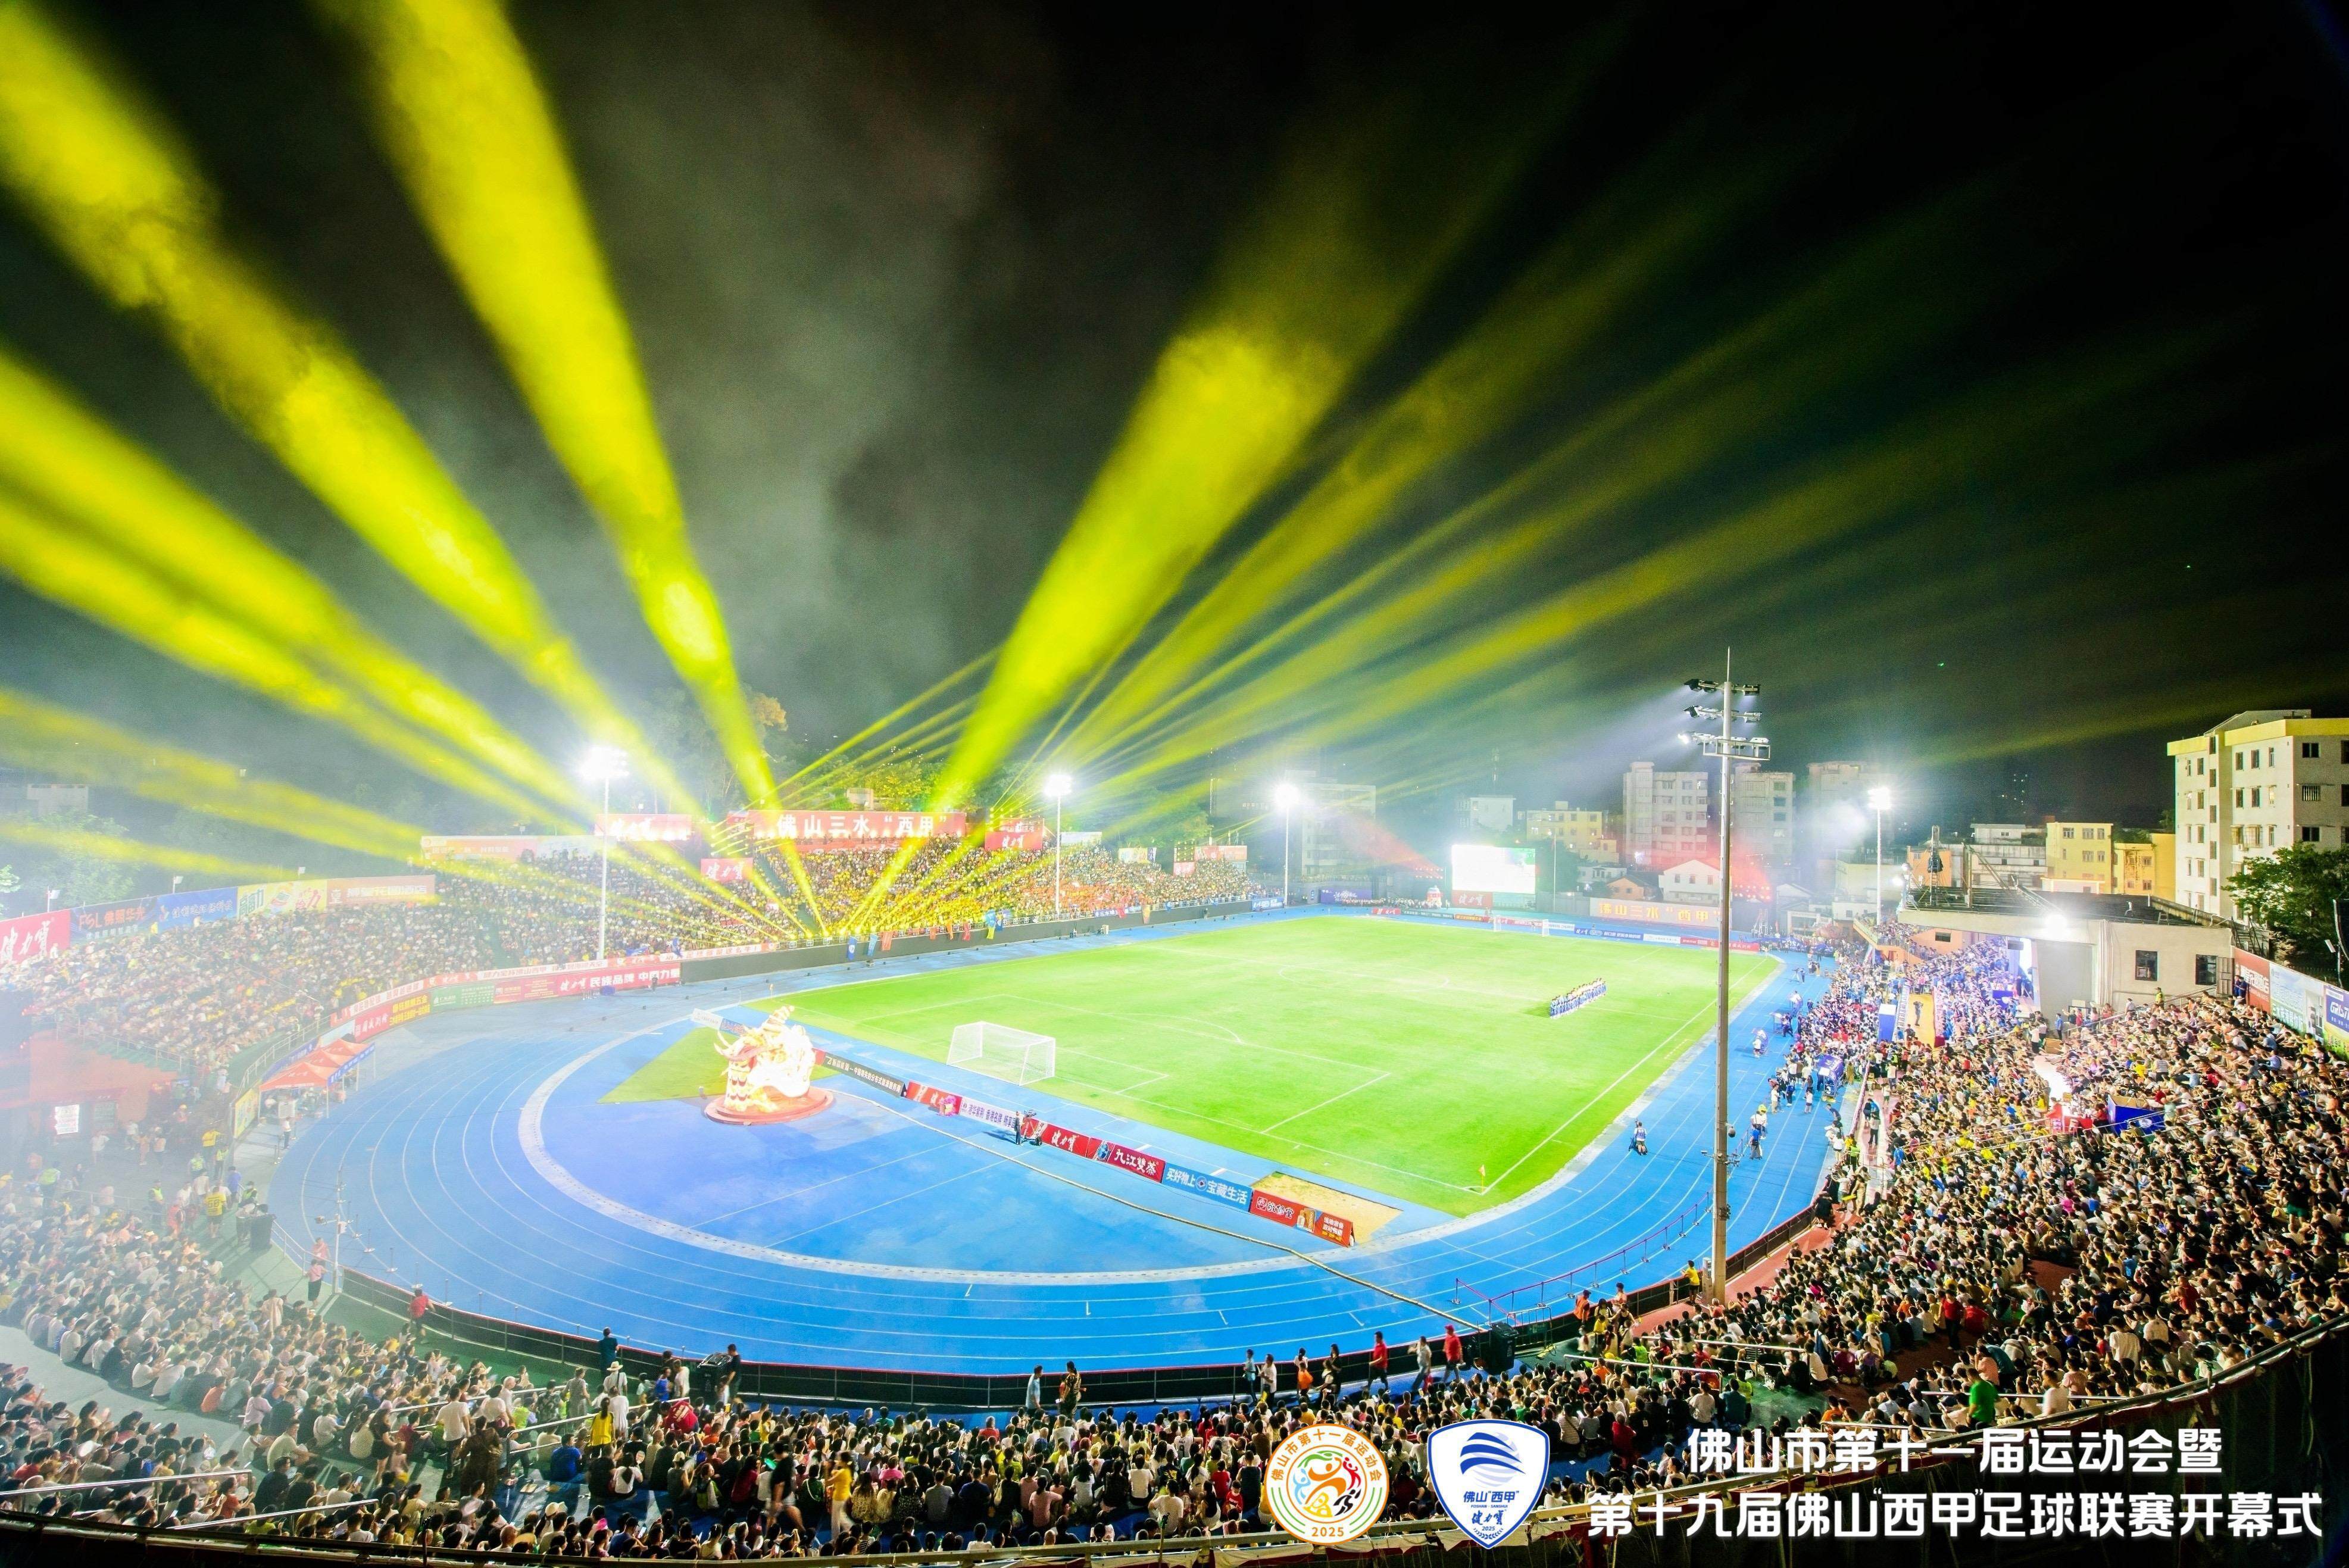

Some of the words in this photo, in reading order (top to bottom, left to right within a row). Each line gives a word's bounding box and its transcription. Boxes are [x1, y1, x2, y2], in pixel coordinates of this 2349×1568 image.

[777, 814, 947, 838] 佛山三水“西甲”
[590, 973, 635, 988] 民族品牌
[1166, 1167, 1196, 1187] 买好物上
[1207, 1180, 1248, 1205] 宝藏生活
[1266, 1200, 1294, 1219] 敬修堂
